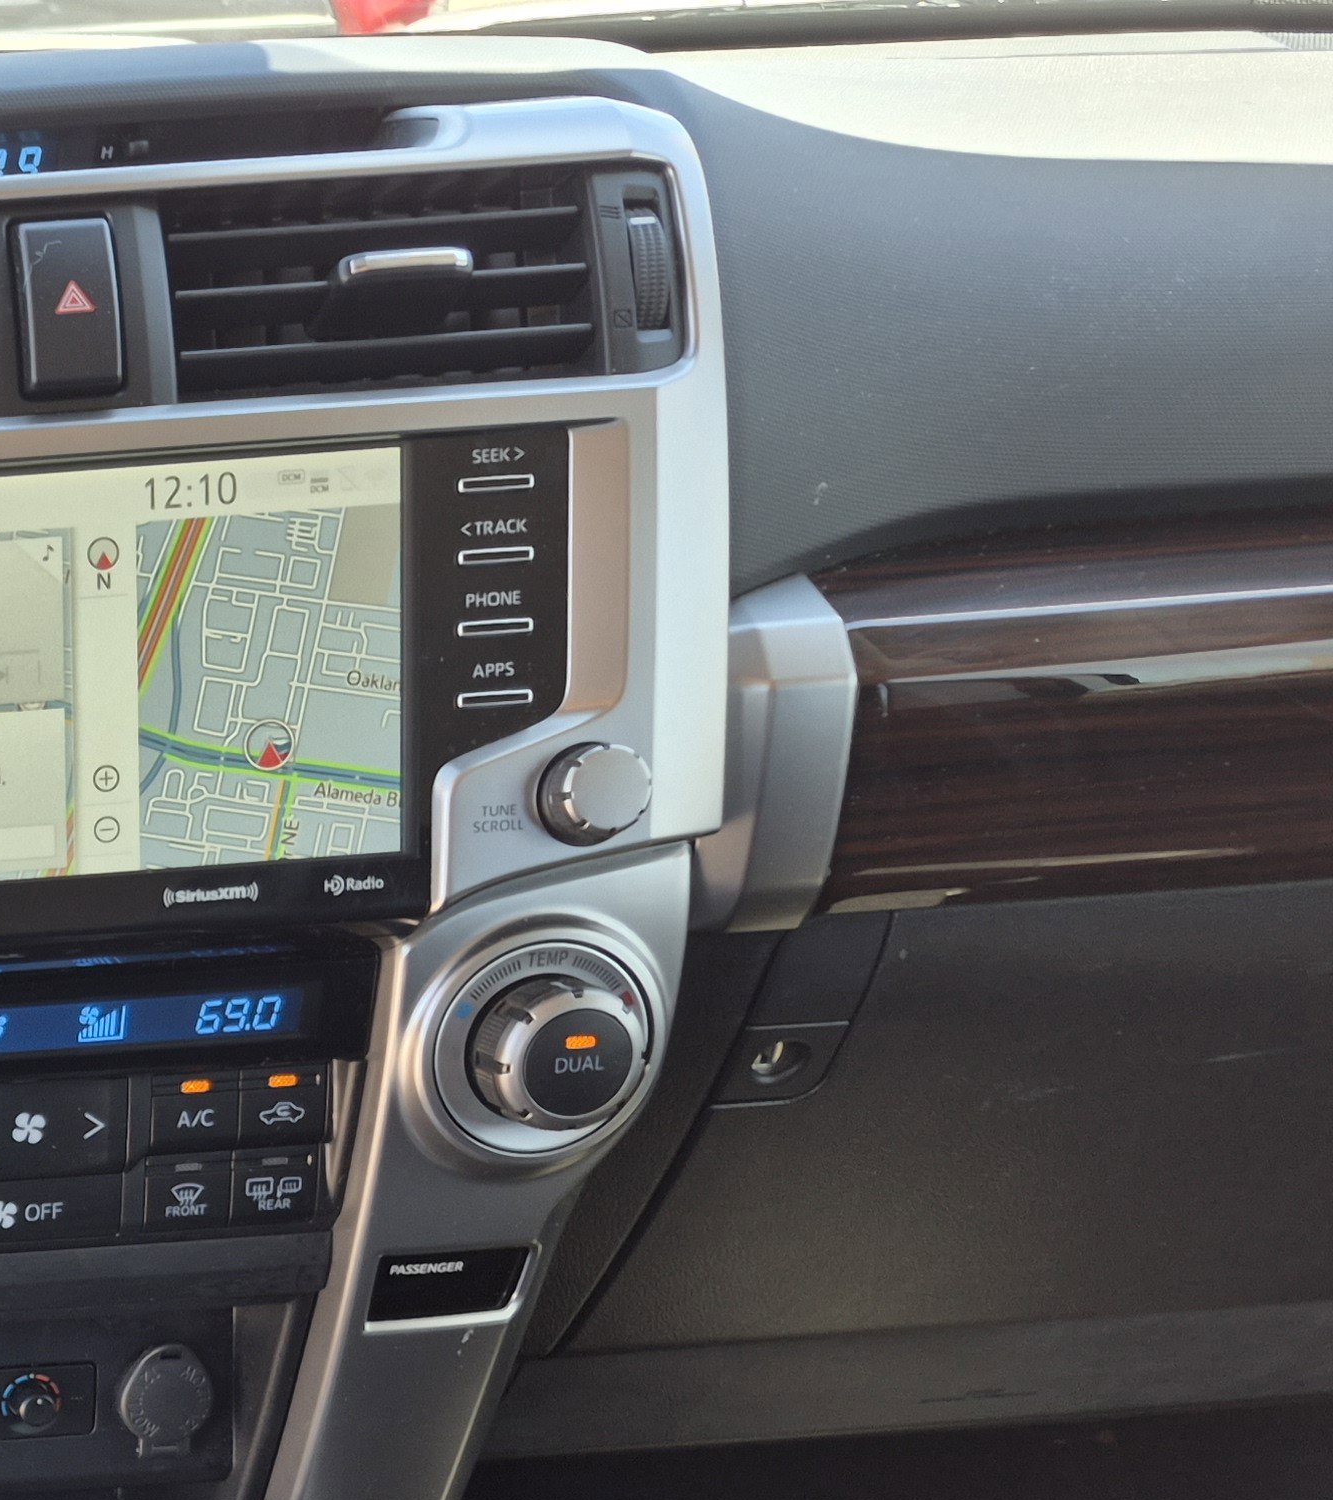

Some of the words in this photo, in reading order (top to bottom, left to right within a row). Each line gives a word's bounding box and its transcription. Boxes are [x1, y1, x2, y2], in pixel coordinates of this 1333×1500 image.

[472, 448, 511, 464] SEEK
[144, 471, 237, 510] 12:10
[474, 518, 527, 536] TRACK
[96, 572, 112, 591] N
[465, 590, 522, 608] PHONE
[472, 661, 515, 679] APPS
[314, 782, 382, 806] Alameda
[481, 804, 517, 818] TUNE
[473, 819, 524, 833] SCROLL
[346, 876, 384, 892] Radio
[528, 950, 570, 967] TEMP
[195, 996, 282, 1034] 69.0
[554, 1056, 604, 1075] DUAL
[177, 1108, 214, 1128] A/C
[25, 1202, 63, 1221] OFF
[165, 1203, 207, 1217] FRONT
[258, 1197, 291, 1211] REAR
[390, 1260, 464, 1275] PASSENGER
